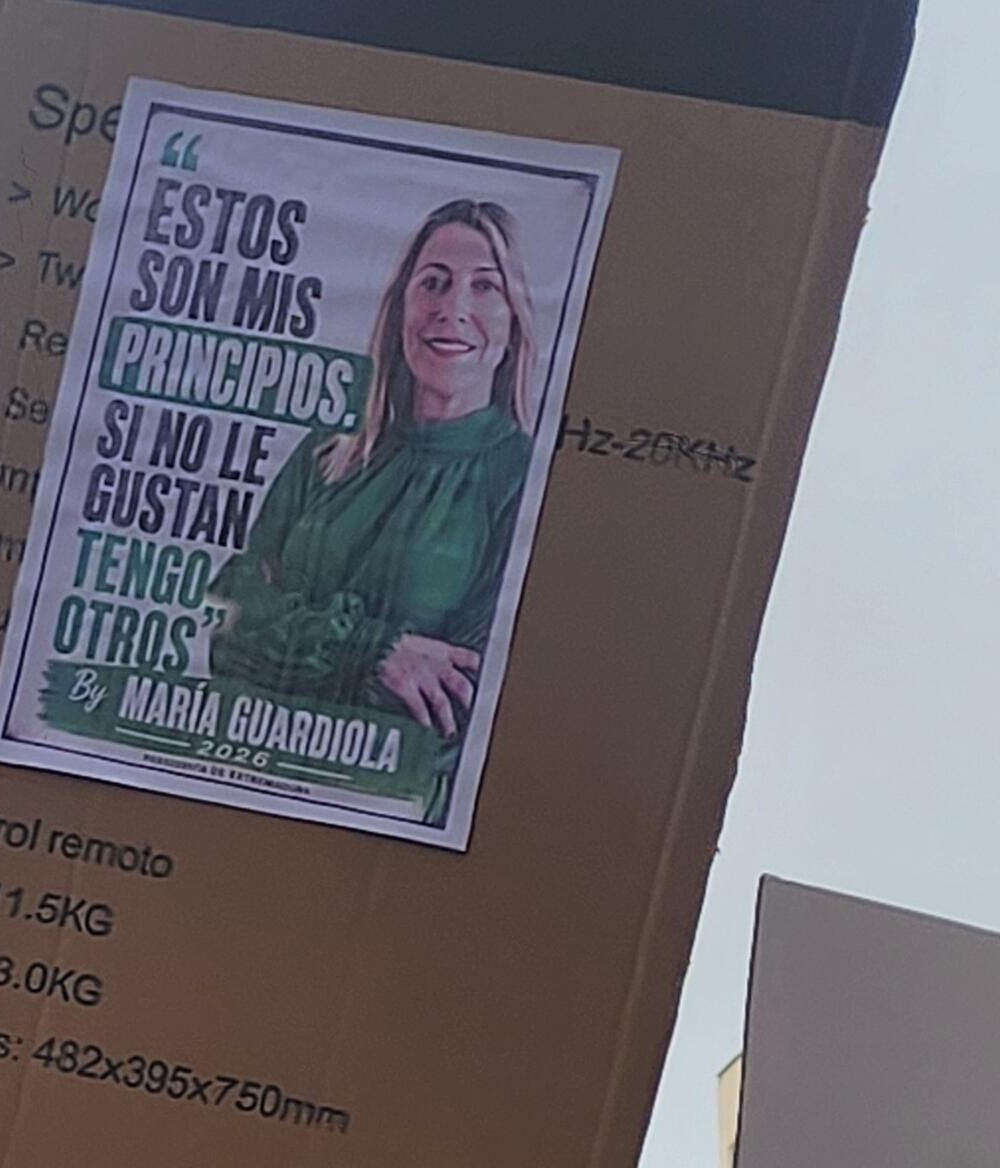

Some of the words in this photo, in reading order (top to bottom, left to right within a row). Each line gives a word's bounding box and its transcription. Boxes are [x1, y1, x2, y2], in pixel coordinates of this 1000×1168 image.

[144, 178, 307, 266] ESTOS
[19, 318, 68, 356] Re
[129, 249, 229, 322] SON
[232, 266, 323, 340] MIS
[110, 323, 358, 427] PRINCIPIOS.
[96, 399, 144, 462] SI
[149, 408, 213, 473] NO
[218, 421, 276, 486] LE
[82, 463, 254, 550] GUSTAN
[73, 527, 212, 610] TENGO
[69, 668, 109, 713] By
[118, 675, 221, 738] MARÍA
[227, 695, 401, 773] GUARDIOLA
[196, 740, 272, 768] 2026
[48, 829, 174, 878] remoto
[32, 1036, 350, 1135] 482x395x750mm
